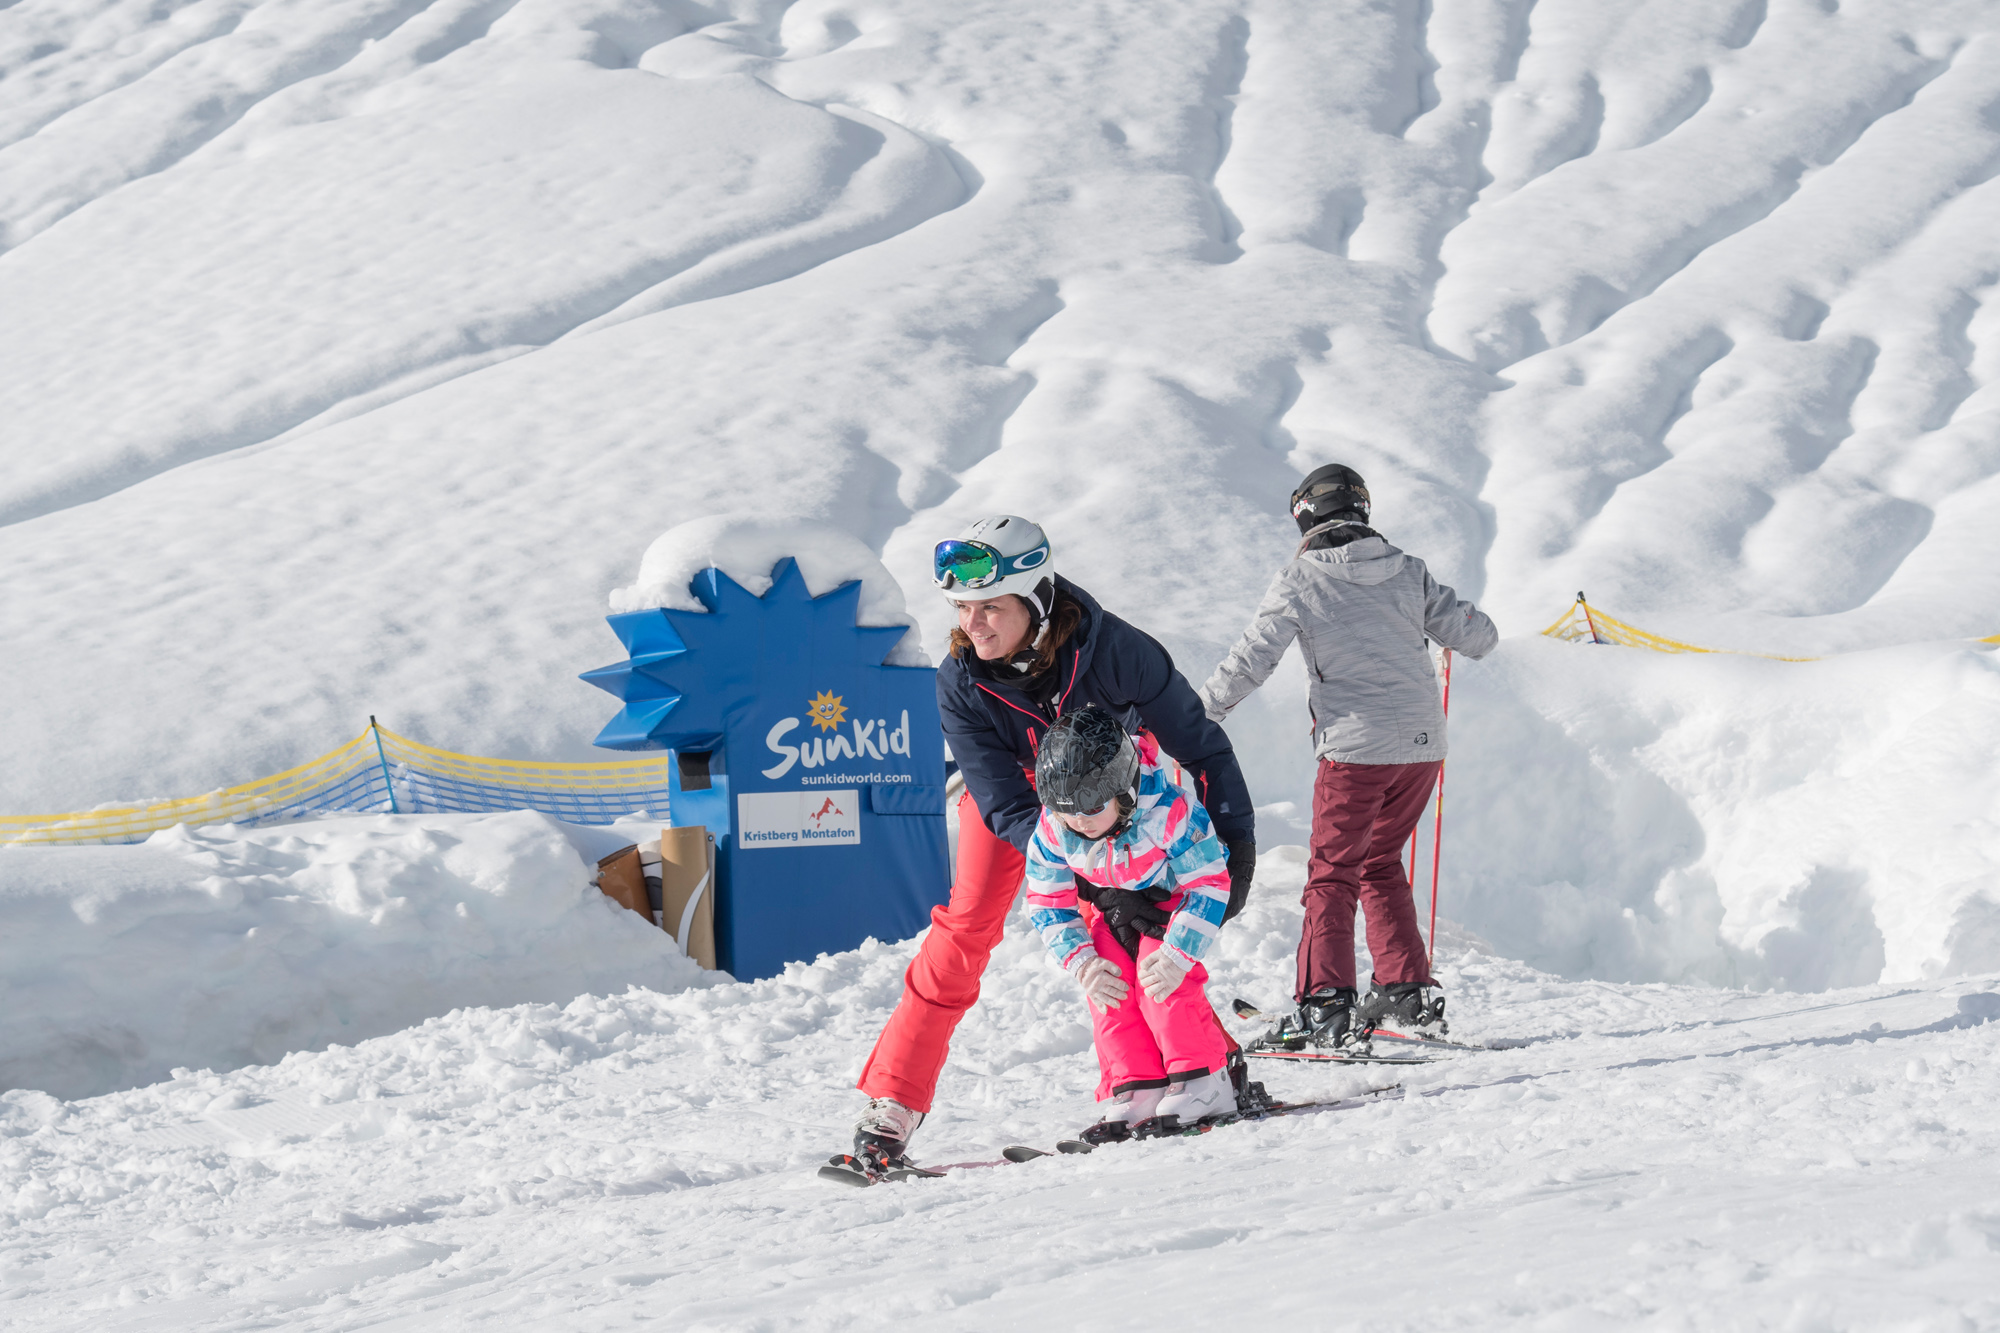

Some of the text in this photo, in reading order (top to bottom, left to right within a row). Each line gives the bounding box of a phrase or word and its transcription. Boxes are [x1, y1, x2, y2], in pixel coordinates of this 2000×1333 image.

[761, 709, 911, 779] SunKid
[801, 772, 911, 785] sunkidworld.com
[744, 828, 855, 842] Kristberg Montafon
